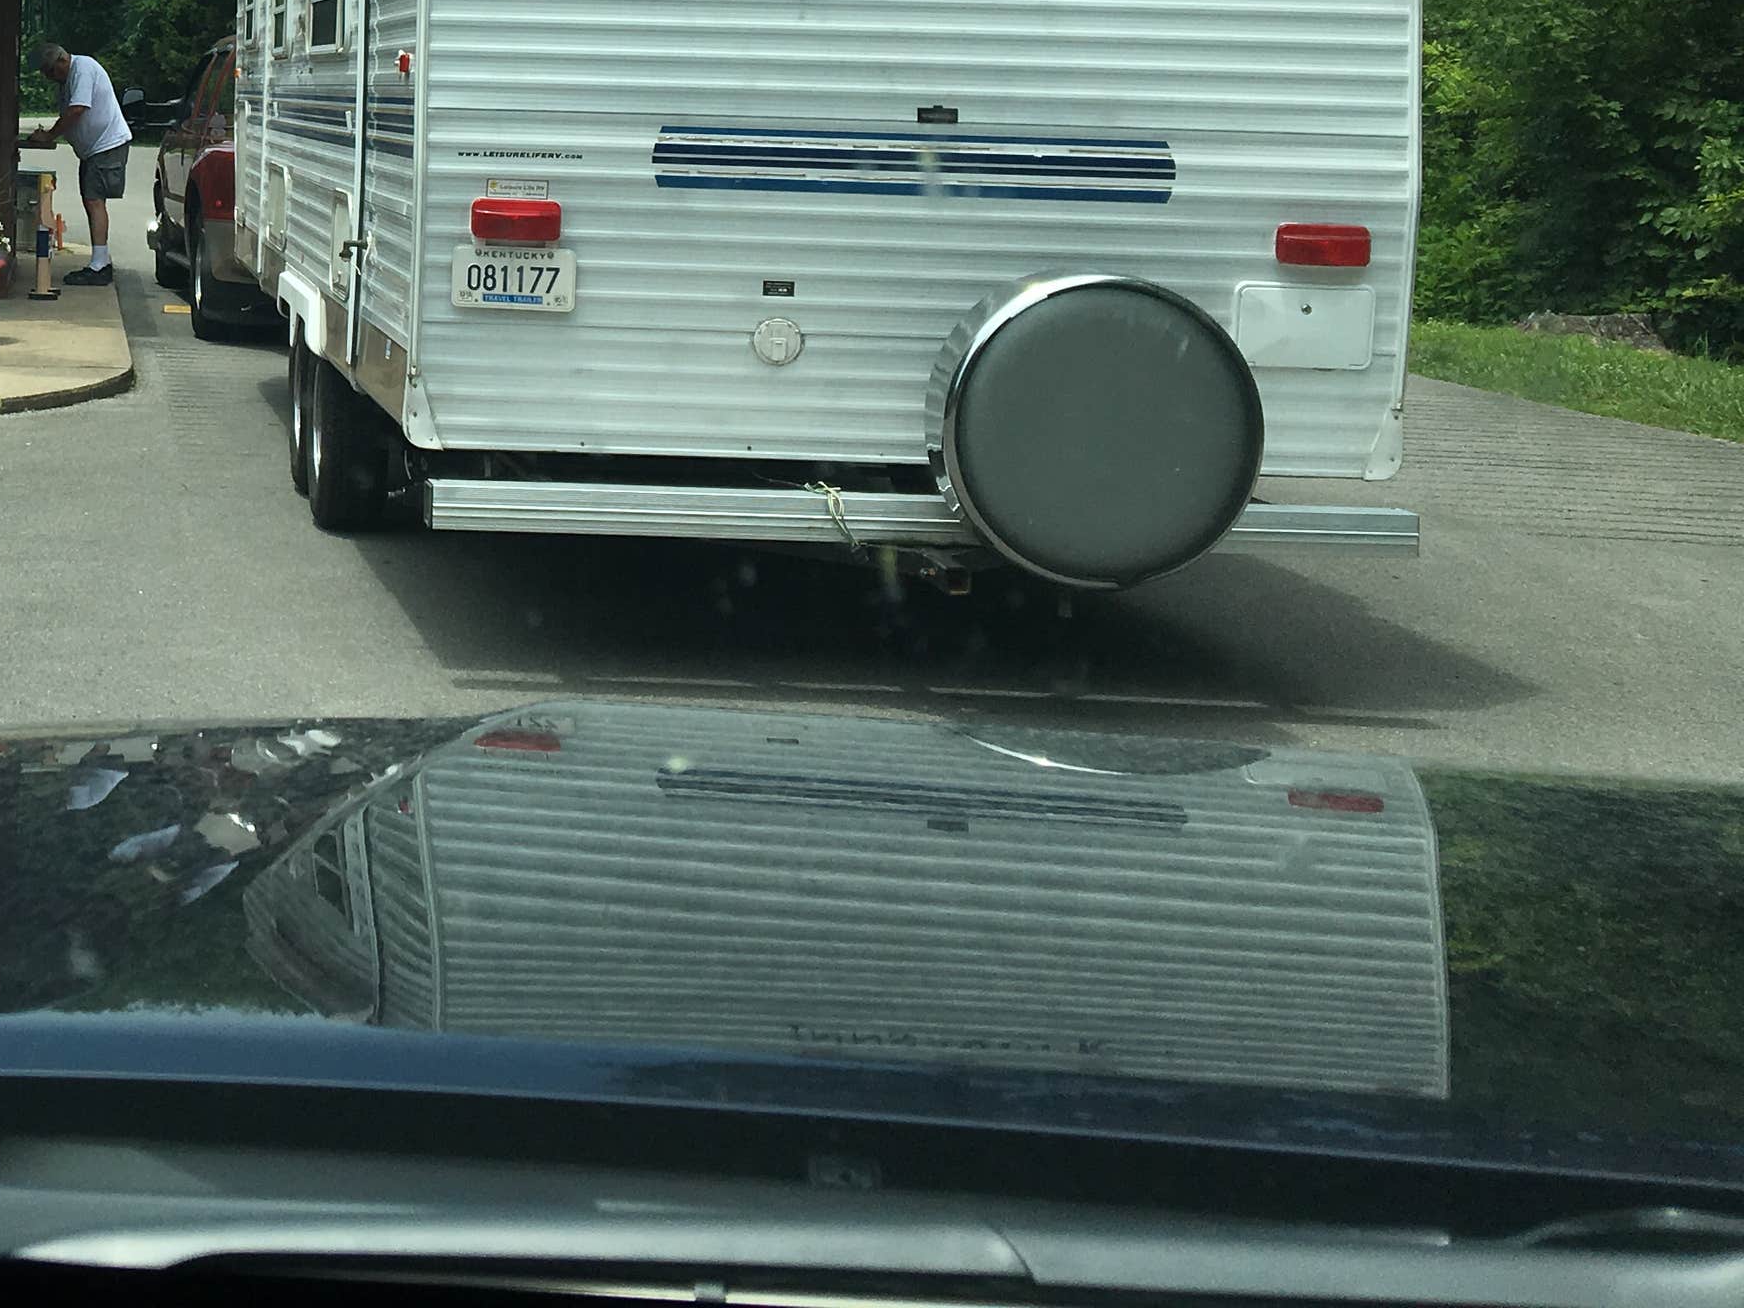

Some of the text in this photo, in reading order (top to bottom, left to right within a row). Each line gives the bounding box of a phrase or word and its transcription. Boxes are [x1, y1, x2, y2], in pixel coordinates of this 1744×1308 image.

[482, 250, 546, 260] KENTUCKY
[467, 263, 561, 294] 081177
[483, 294, 512, 303] TRAVEL
[513, 295, 543, 304] TRAILER
